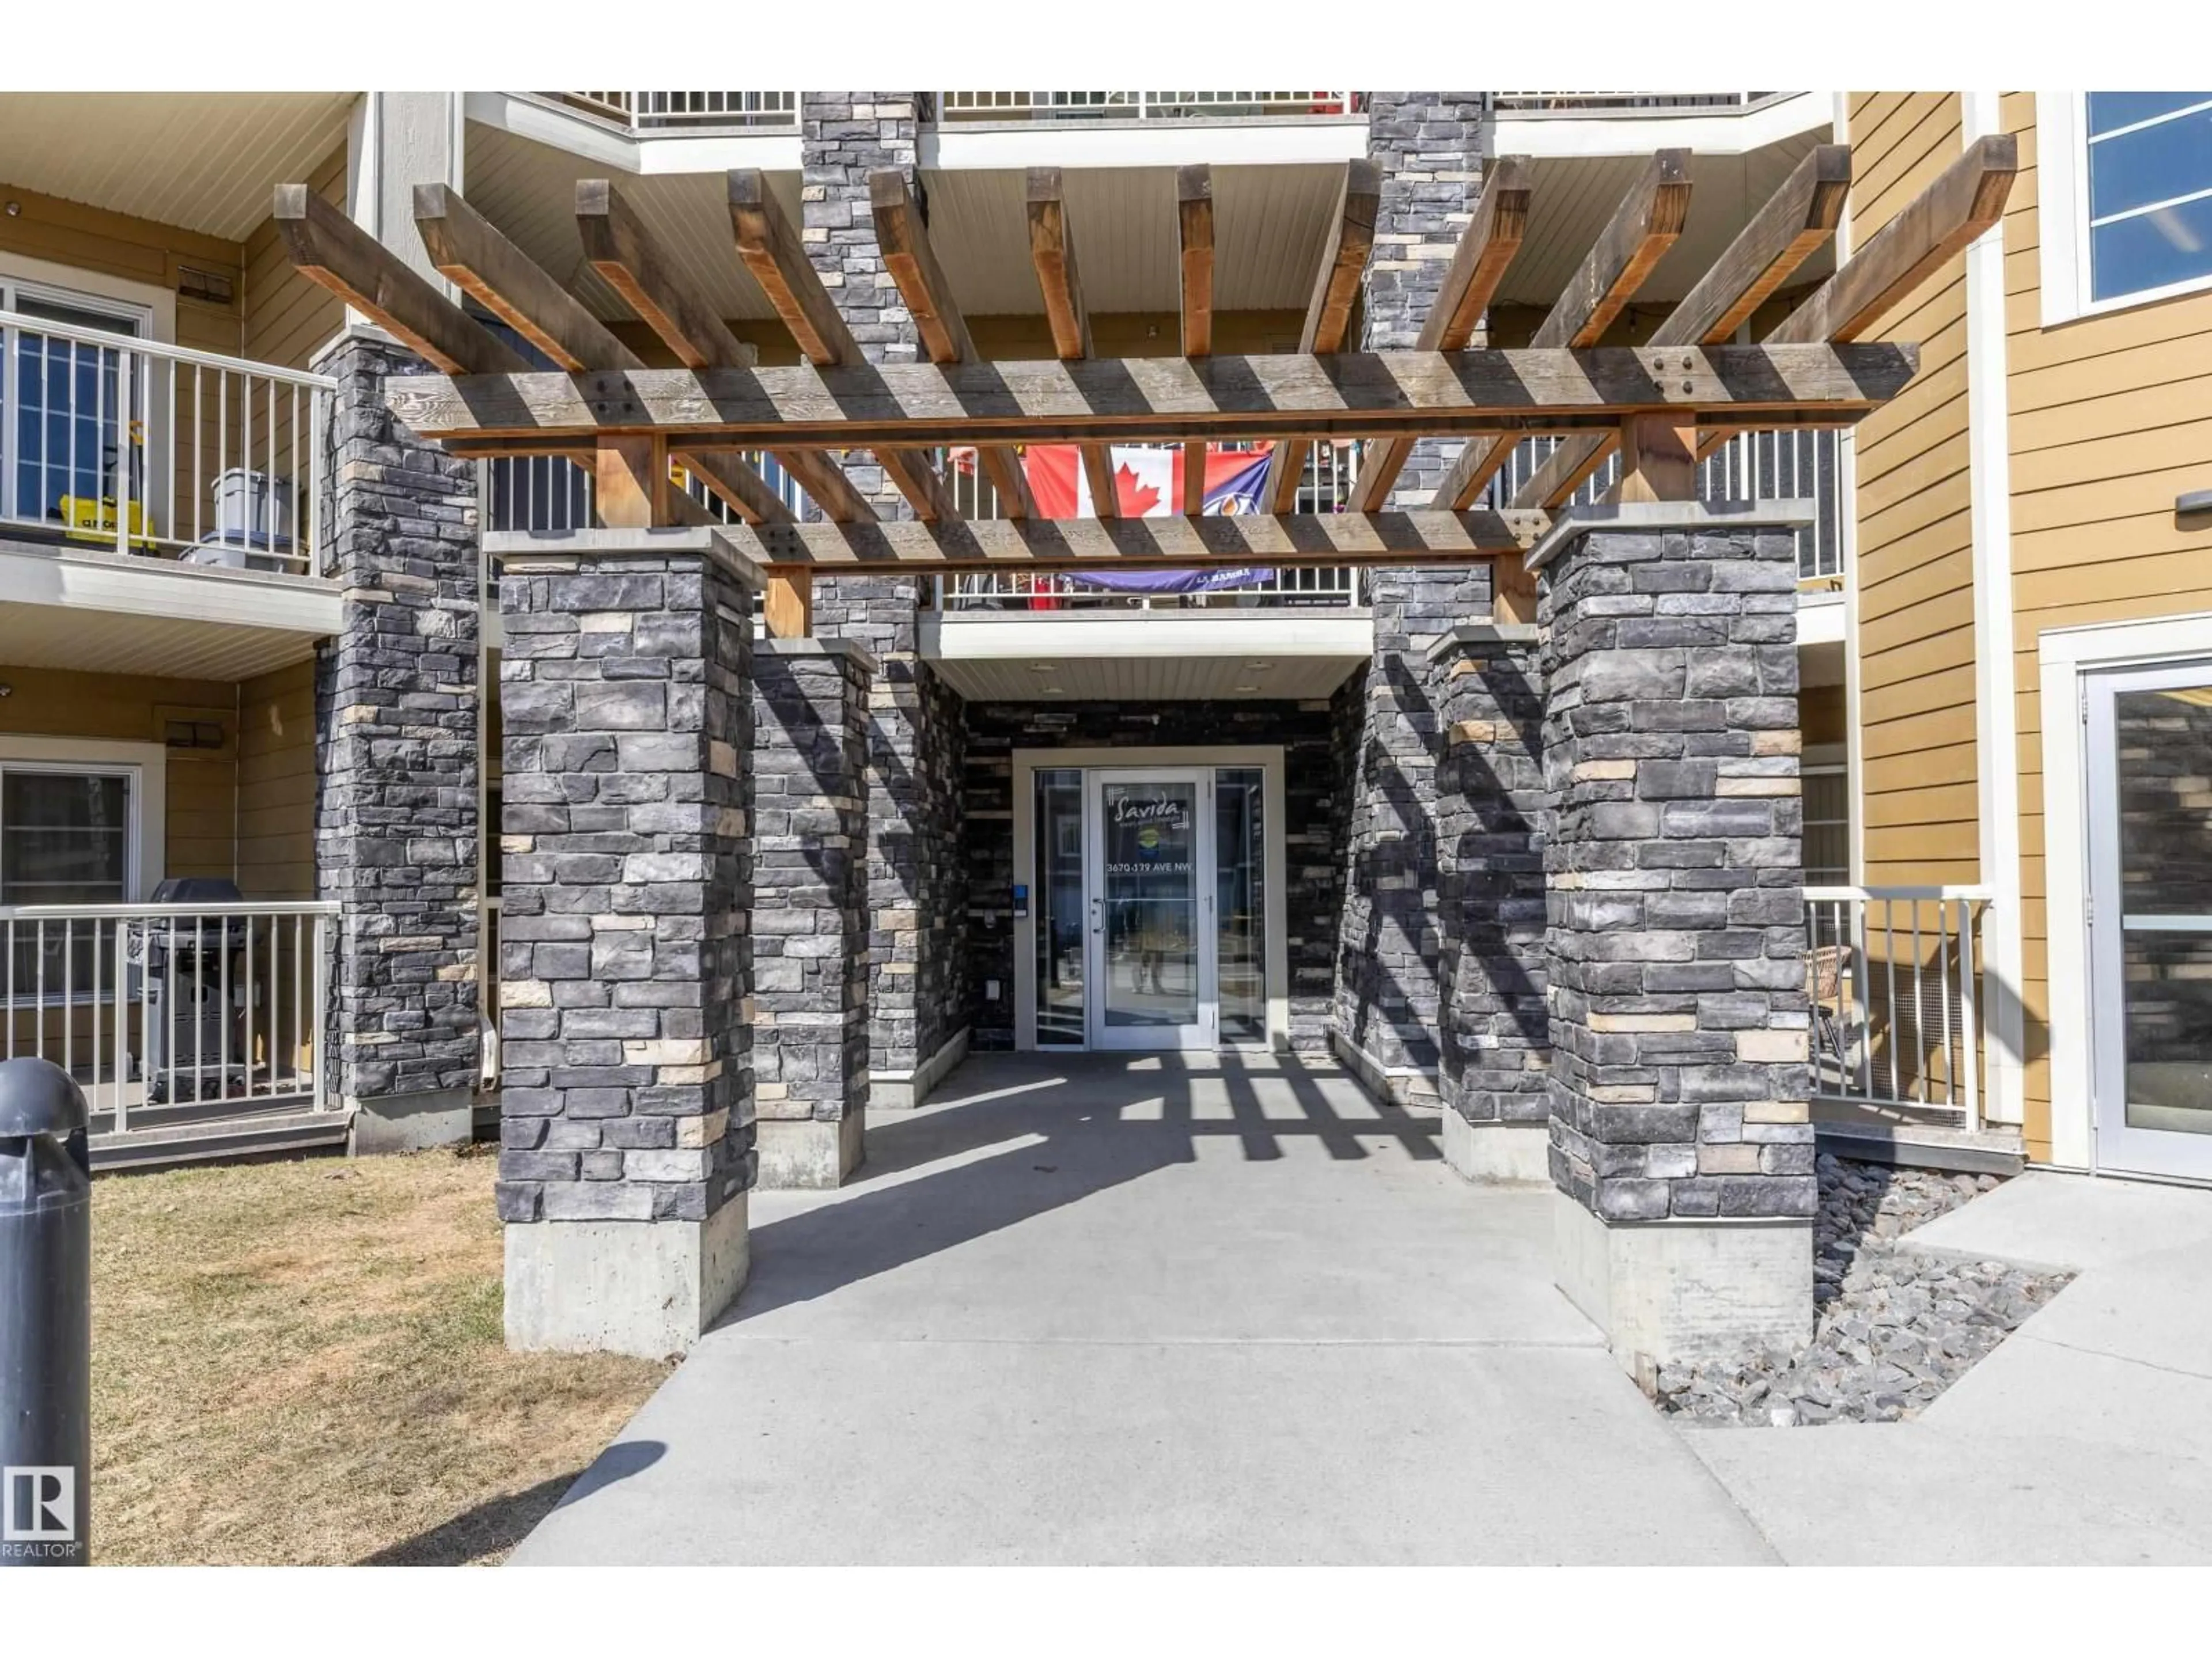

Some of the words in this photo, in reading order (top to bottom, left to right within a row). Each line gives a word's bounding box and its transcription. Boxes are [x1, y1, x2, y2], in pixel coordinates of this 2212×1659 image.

[1115, 791, 1180, 822] Savida
[1153, 863, 1172, 872] AVE
[1175, 863, 1193, 872] NW
